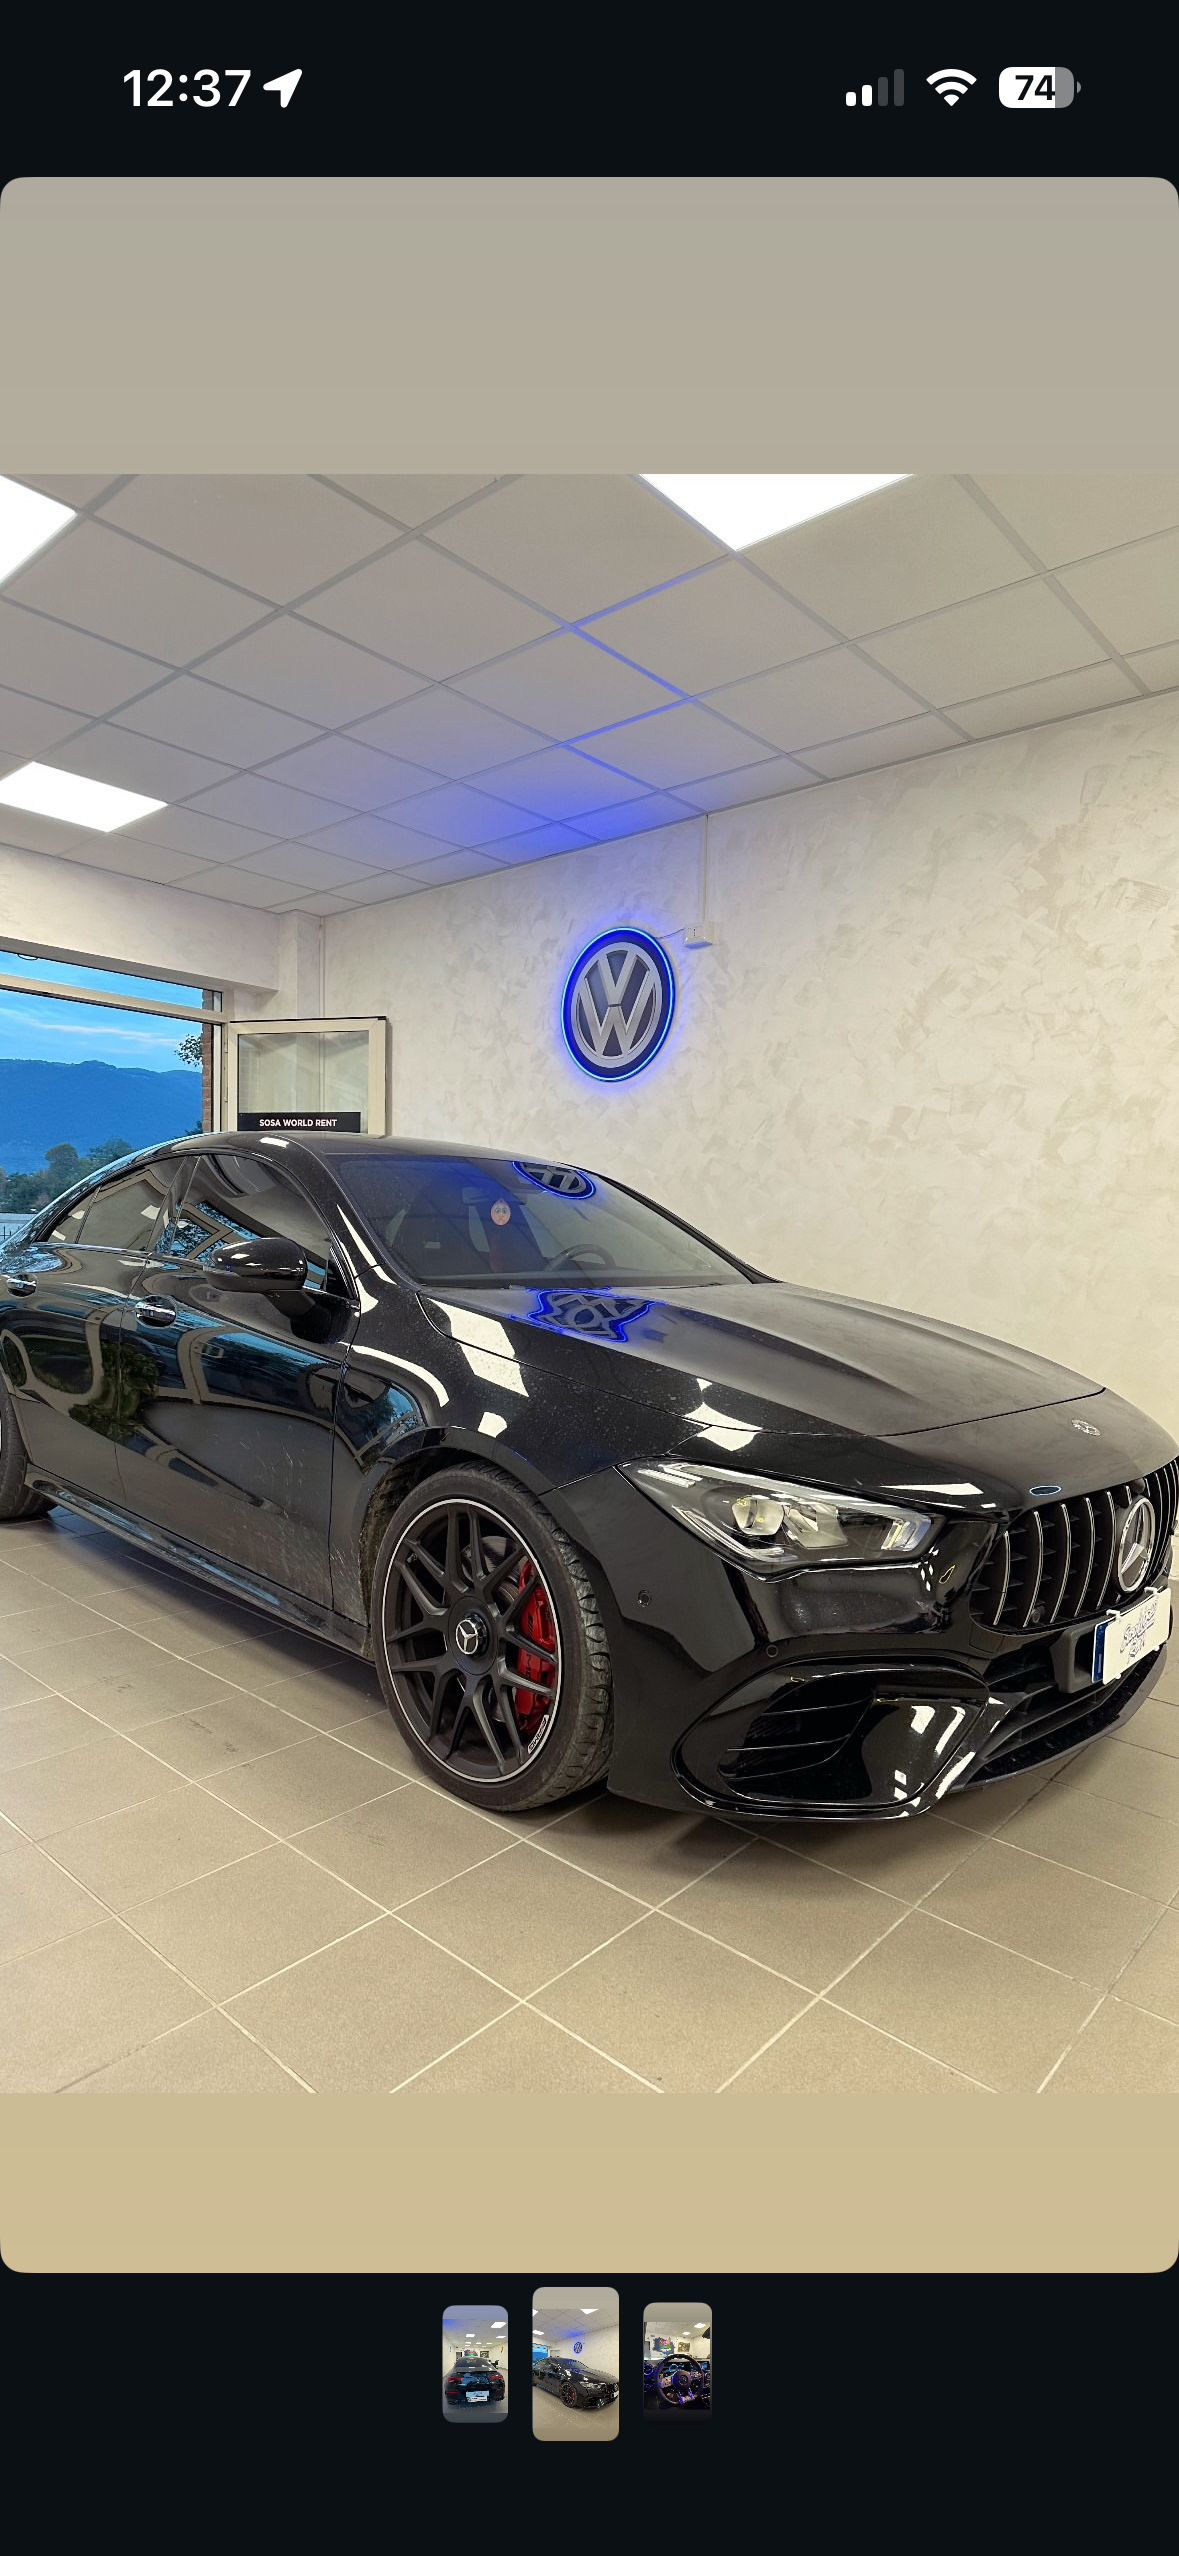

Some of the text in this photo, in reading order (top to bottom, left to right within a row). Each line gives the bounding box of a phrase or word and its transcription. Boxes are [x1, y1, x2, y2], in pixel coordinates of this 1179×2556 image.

[575, 946, 660, 1059] VW
[259, 1118, 338, 1127] SOSA WORLD RENT
